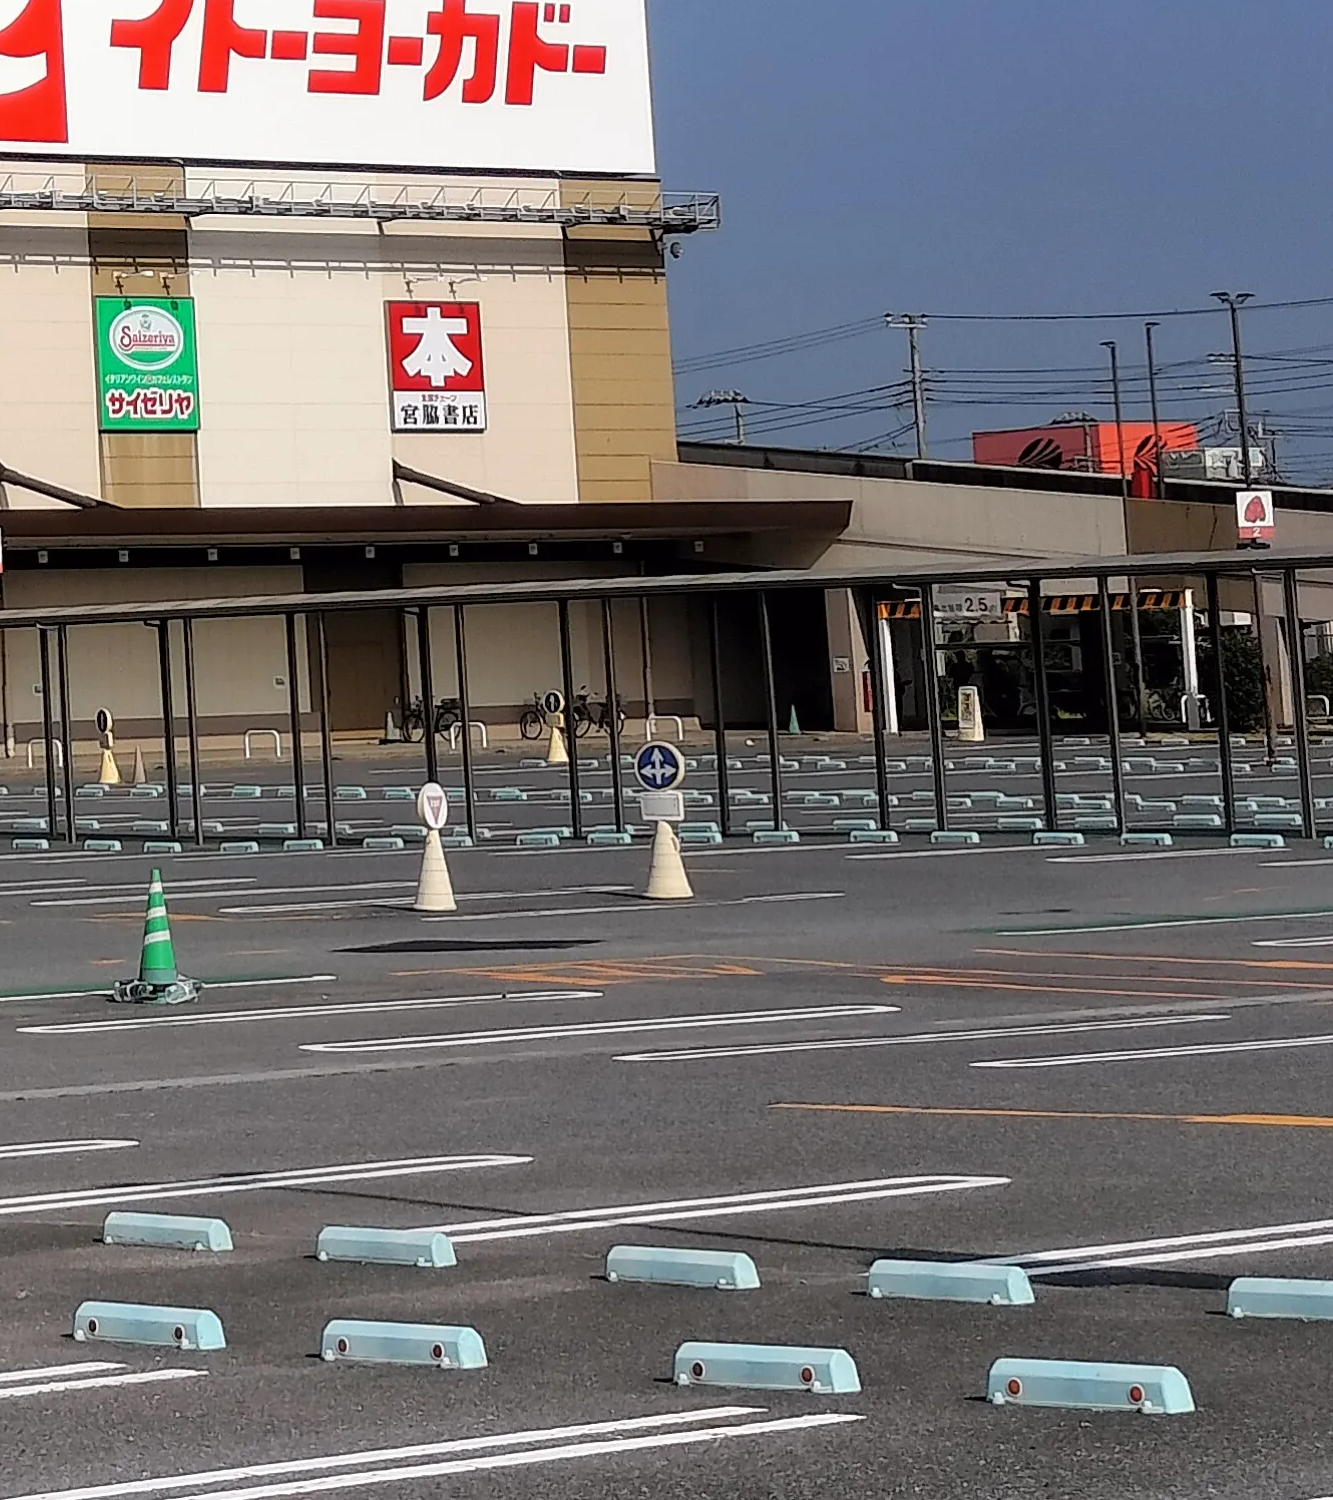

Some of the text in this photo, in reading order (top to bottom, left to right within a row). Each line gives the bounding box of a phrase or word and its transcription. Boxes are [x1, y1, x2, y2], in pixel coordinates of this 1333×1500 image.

[119, 325, 176, 349] Saizeriya
[400, 306, 473, 387] 本
[107, 389, 193, 417] サイゼリヤ
[400, 403, 479, 426] 宮脇書店
[1252, 527, 1262, 538] 2
